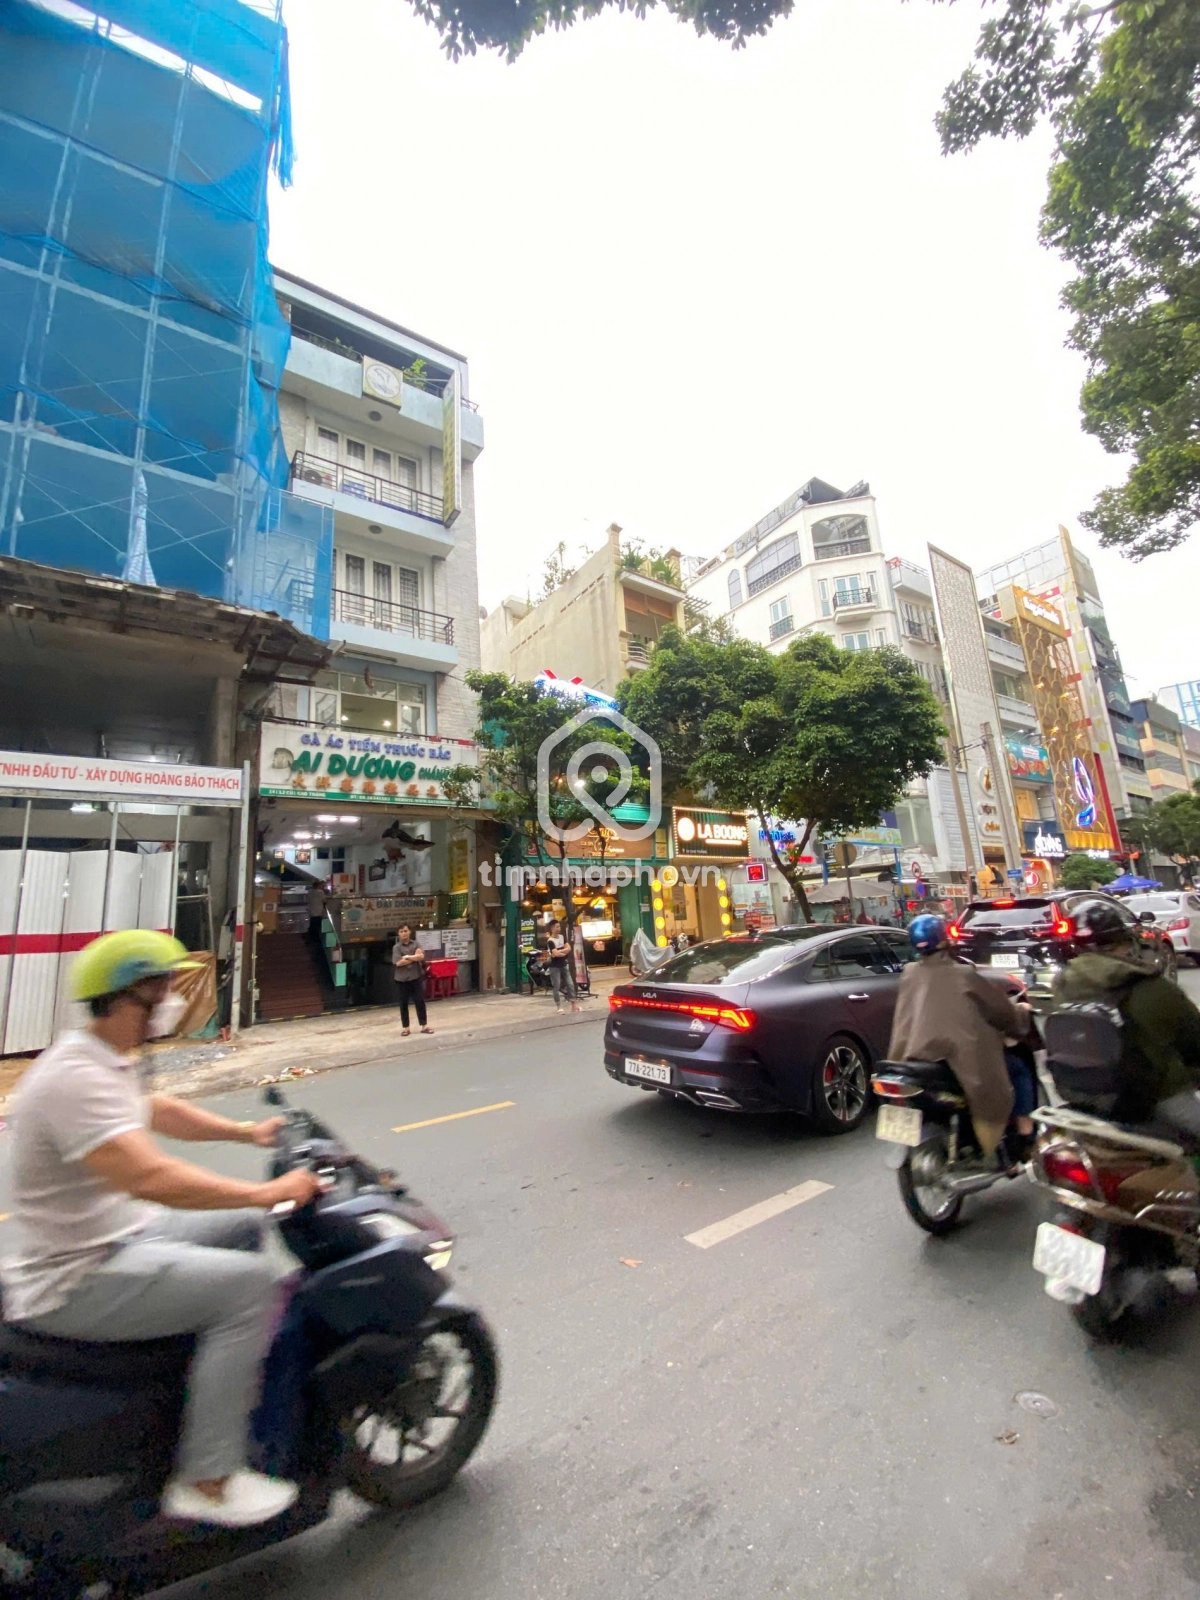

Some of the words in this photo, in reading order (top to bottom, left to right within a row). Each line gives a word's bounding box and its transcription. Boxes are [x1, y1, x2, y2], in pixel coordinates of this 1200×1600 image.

[62, 766, 78, 779] TƯ
[86, 768, 107, 781] XÂY
[110, 770, 142, 786] DỰNG
[144, 772, 182, 786] HOÀNG
[185, 774, 205, 788] BẢO
[207, 777, 240, 792] THẠCH
[697, 823, 712, 838] LA
[714, 824, 747, 841] BOONG
[628, 1061, 666, 1080] 77A-221.73
